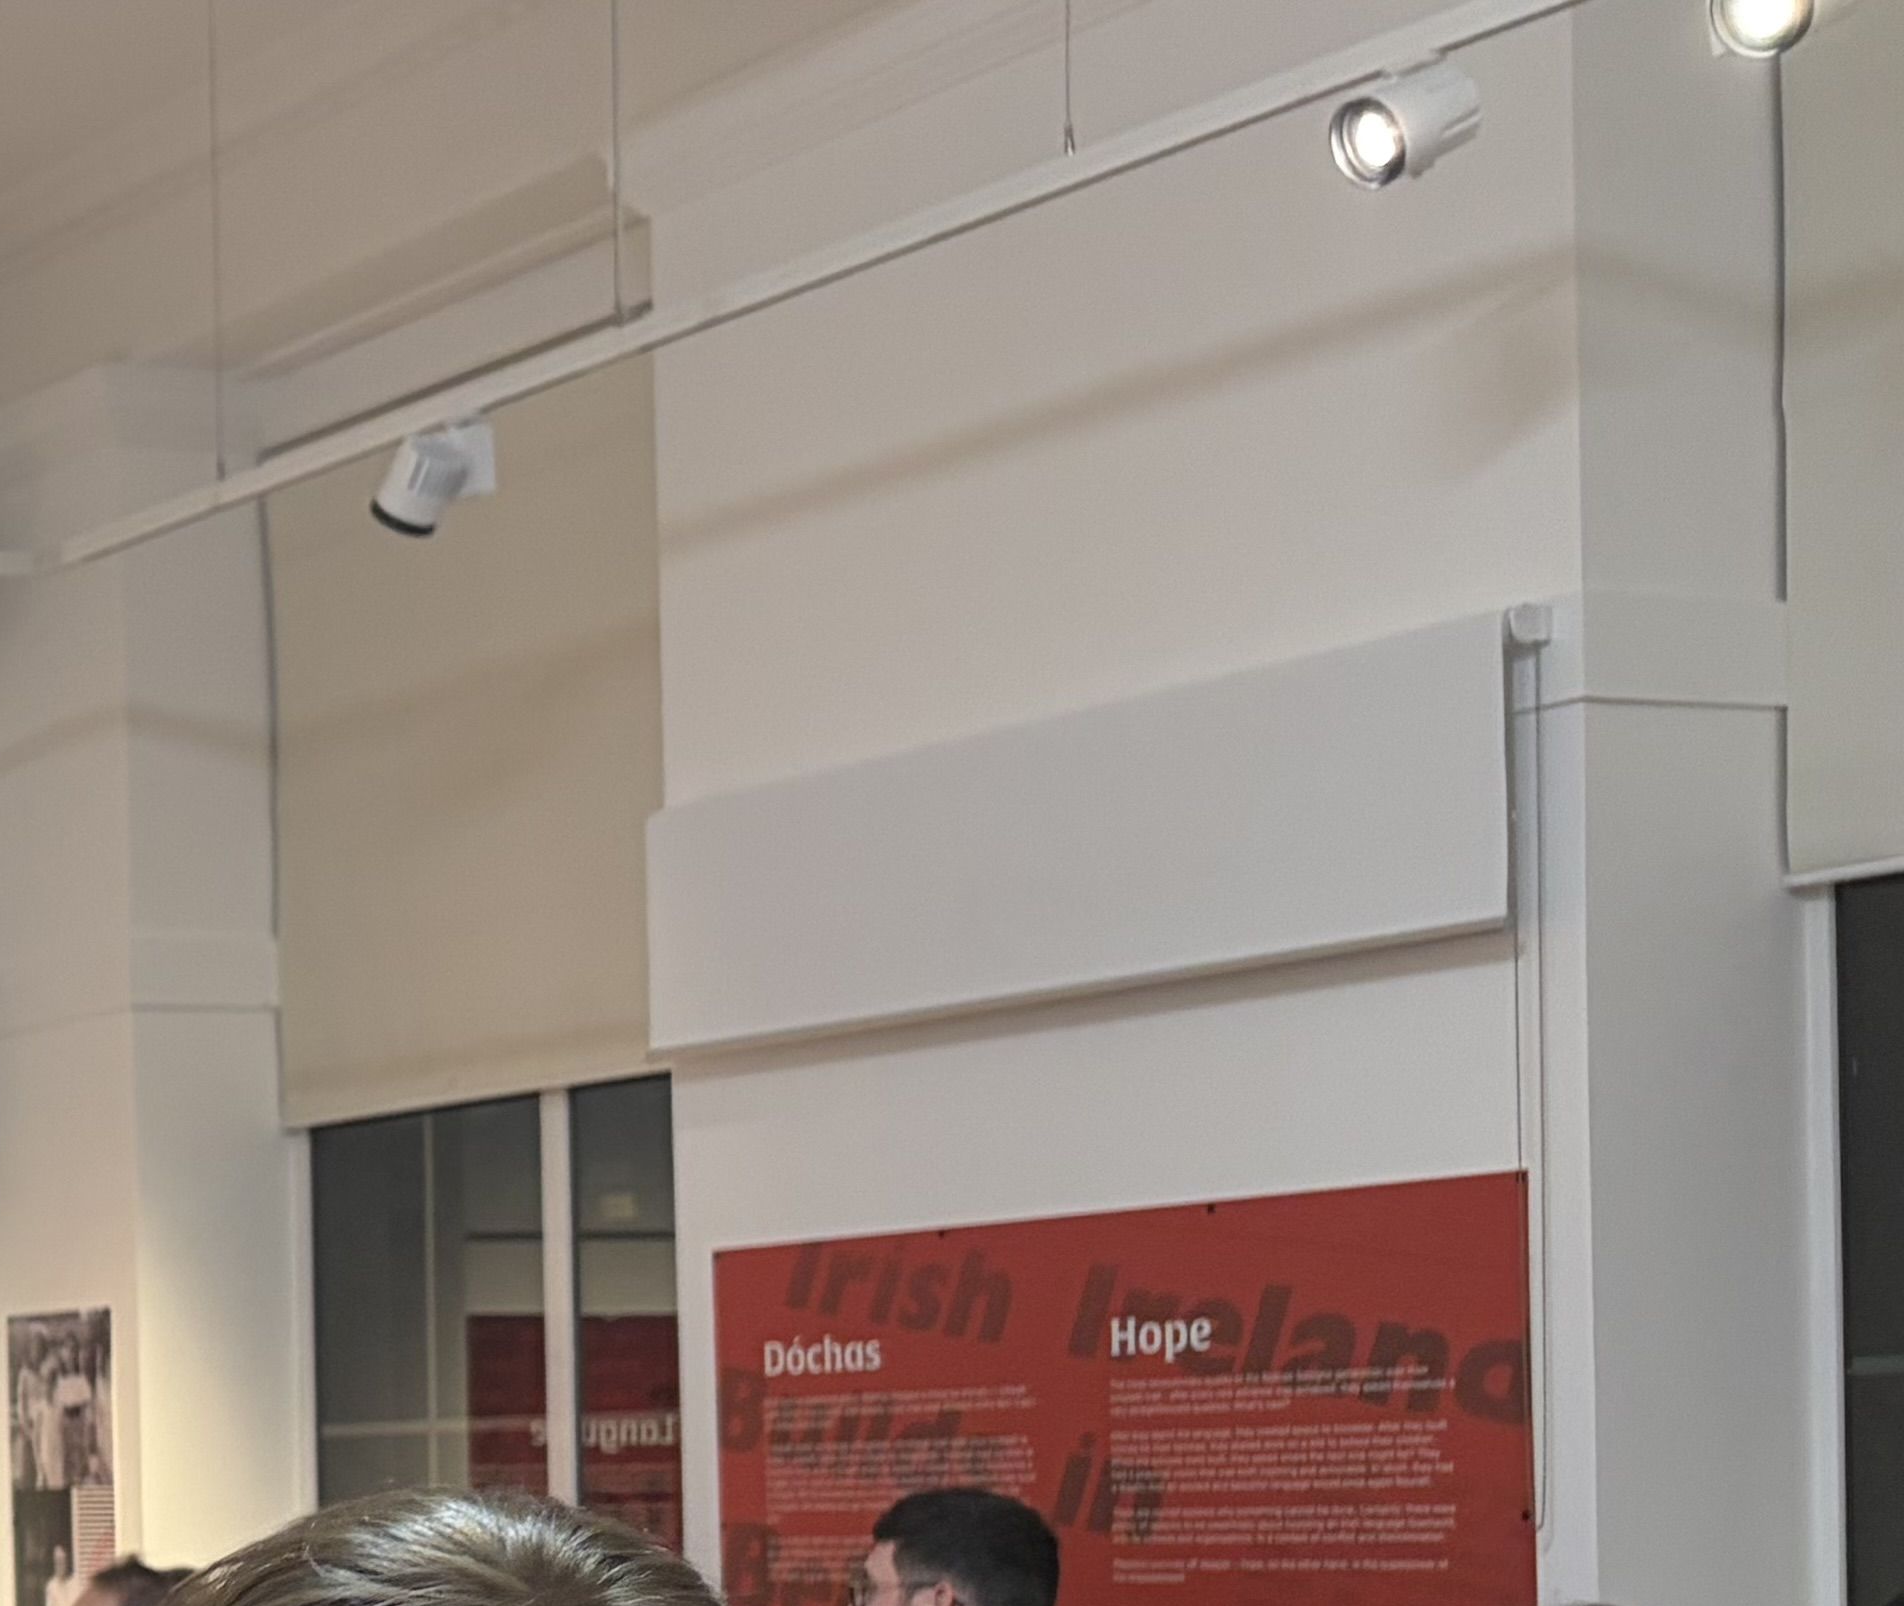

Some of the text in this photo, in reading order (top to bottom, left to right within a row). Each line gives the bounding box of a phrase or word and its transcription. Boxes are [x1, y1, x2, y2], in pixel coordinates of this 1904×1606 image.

[785, 1243, 1014, 1344] Irish
[763, 1333, 882, 1378] Dóchas
[1109, 1315, 1213, 1363] Hope
